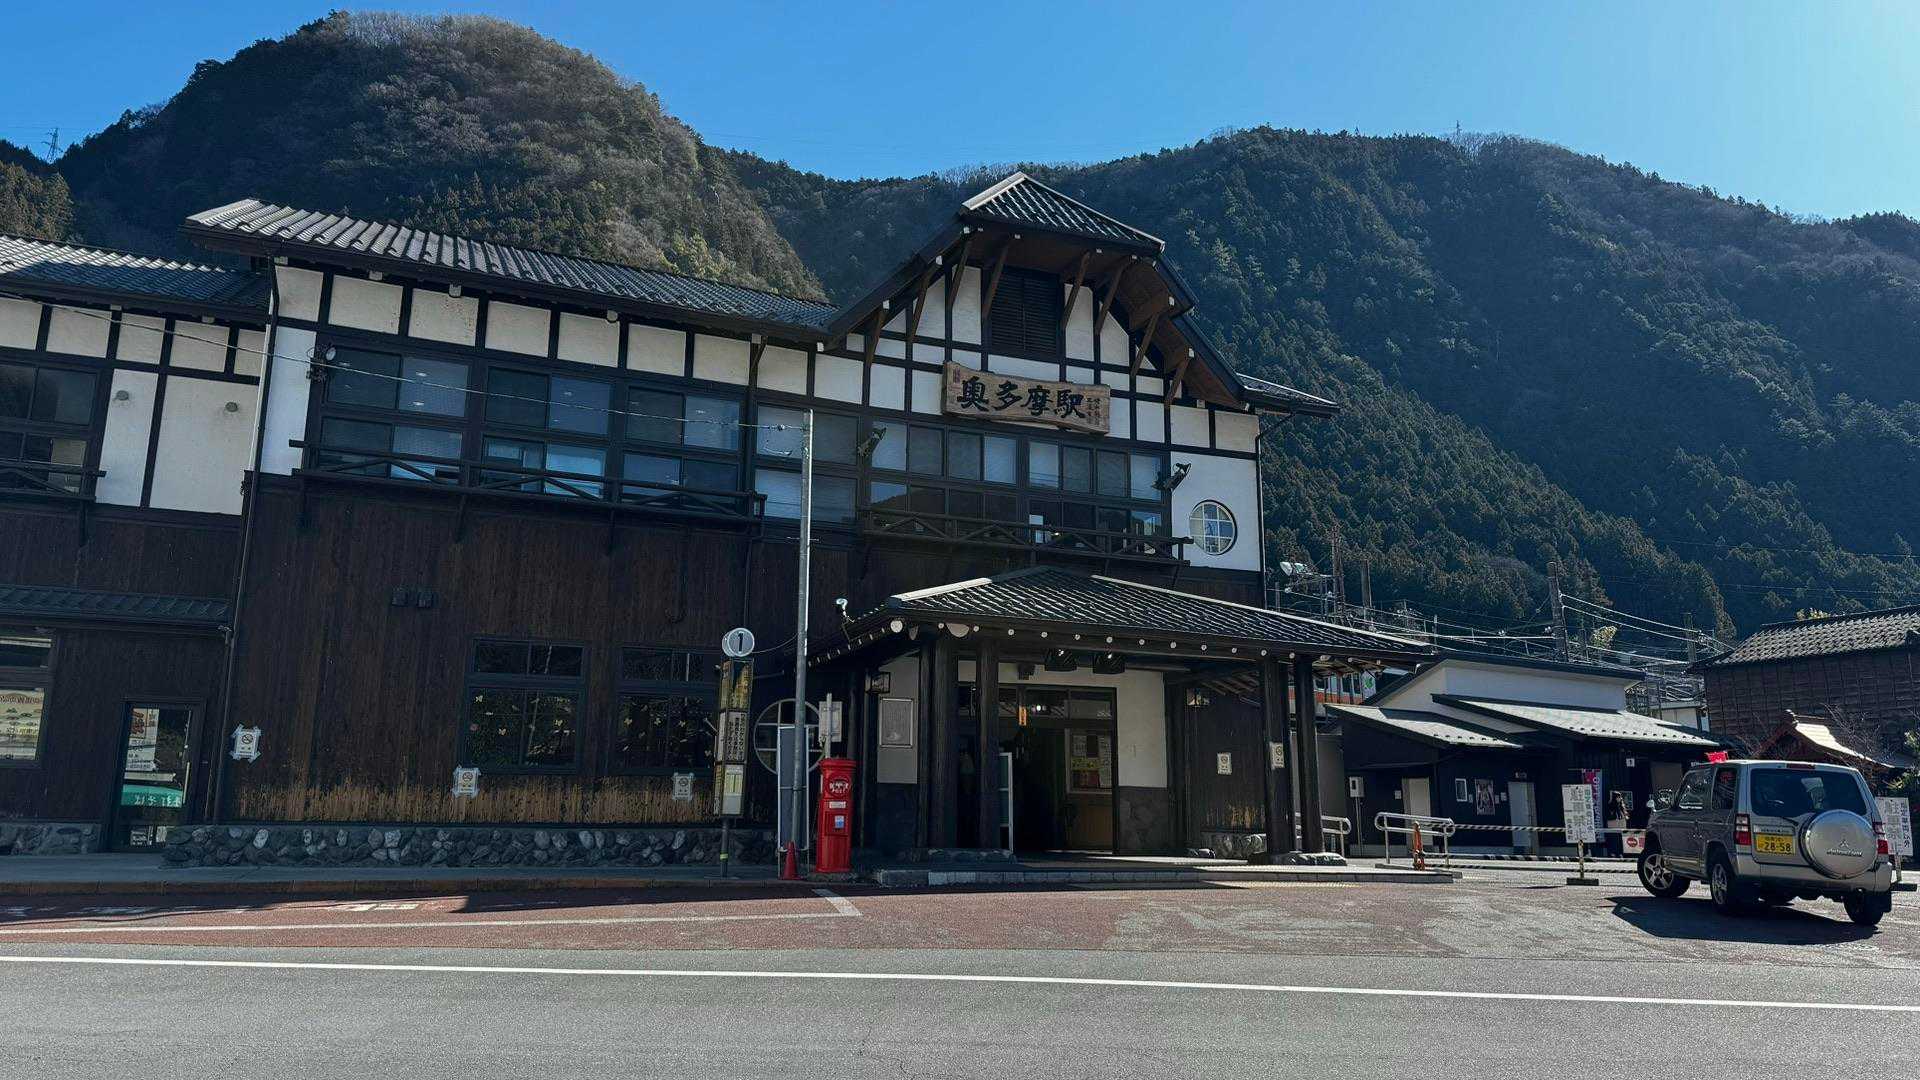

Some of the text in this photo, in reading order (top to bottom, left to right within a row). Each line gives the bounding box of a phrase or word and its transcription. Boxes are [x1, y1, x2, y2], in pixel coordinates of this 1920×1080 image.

[957, 375, 1087, 419] 奥多摩駅
[737, 632, 744, 652] 1
[1764, 842, 1791, 852] 28-58
